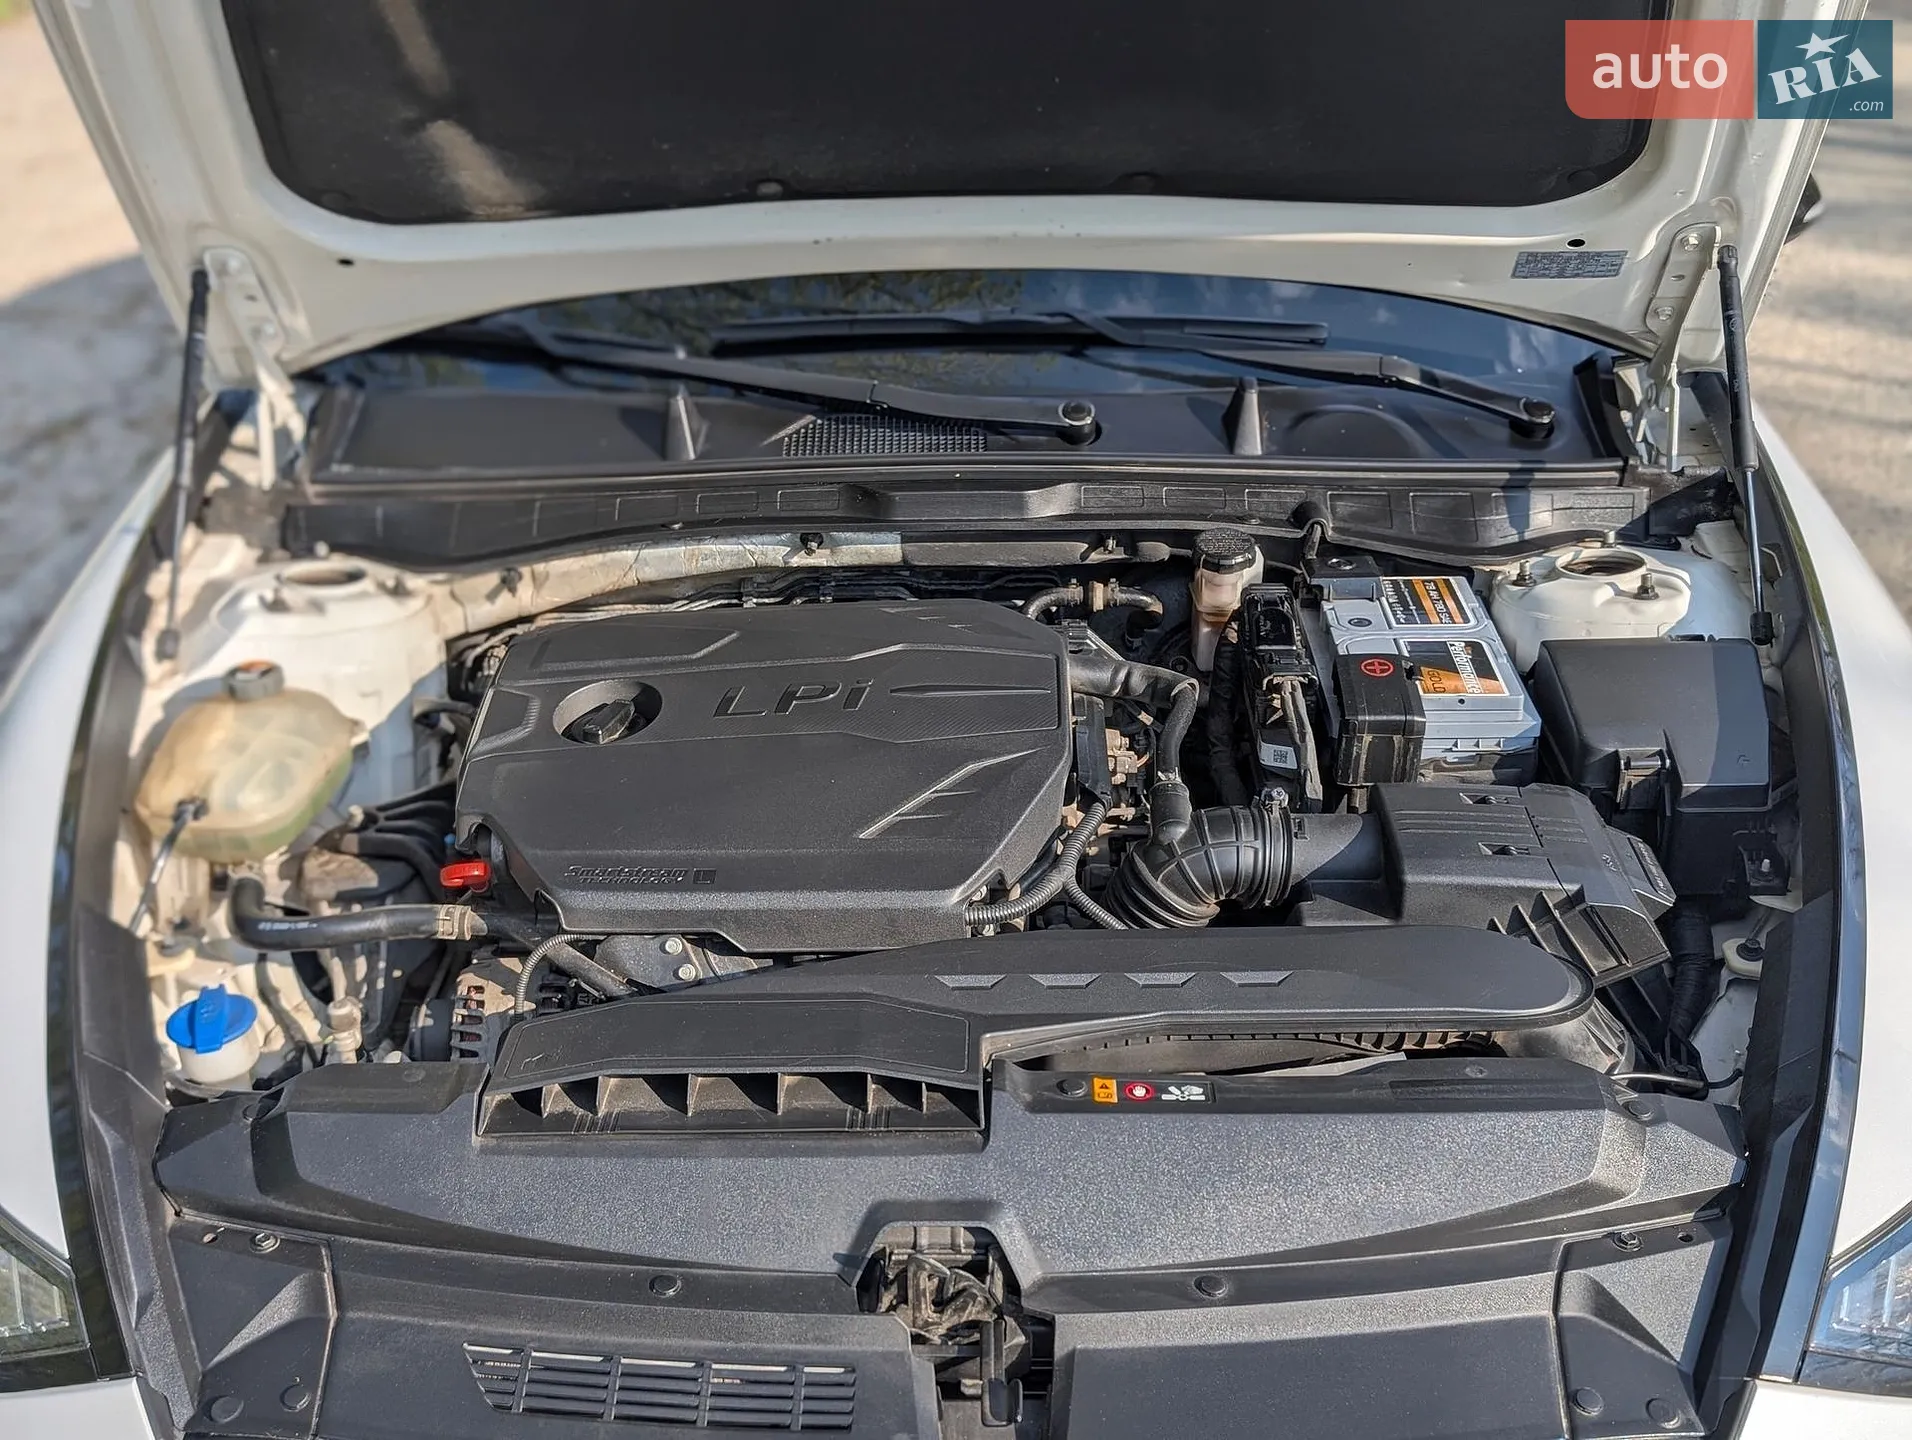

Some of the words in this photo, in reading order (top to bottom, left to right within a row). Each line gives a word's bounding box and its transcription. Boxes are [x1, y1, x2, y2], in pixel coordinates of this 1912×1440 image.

[1427, 670, 1447, 693] GOLD
[1448, 641, 1482, 694] Performance
[713, 677, 874, 718] LPi
